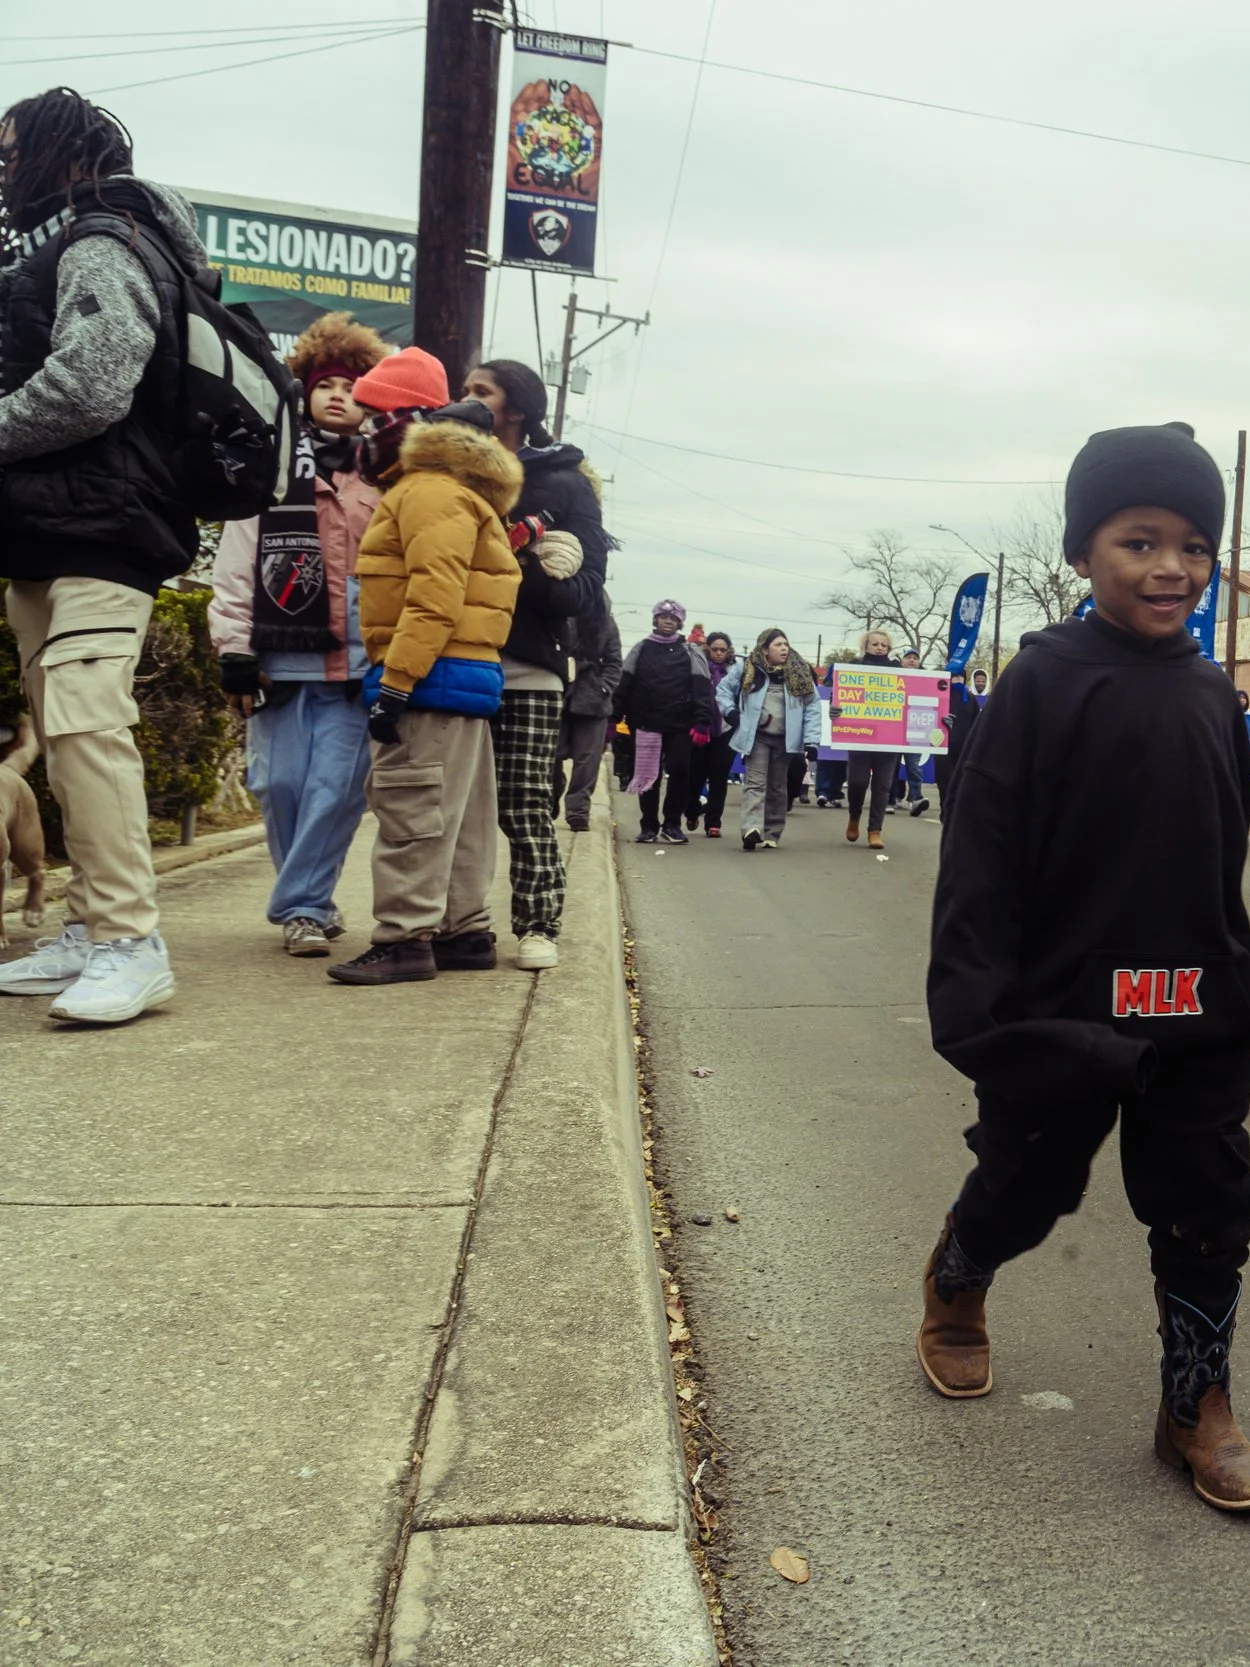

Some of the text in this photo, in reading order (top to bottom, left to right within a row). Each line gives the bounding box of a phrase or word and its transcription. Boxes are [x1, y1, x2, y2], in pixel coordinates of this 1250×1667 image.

[517, 31, 606, 58] LET FREEDOM RING
[548, 78, 572, 95] NO
[513, 162, 590, 195] EQUAL
[206, 215, 417, 283] LESIONADO?
[228, 264, 301, 292] TRATAMOS
[305, 275, 348, 297] COMO
[351, 280, 411, 305] FAMILIA!
[264, 538, 284, 548] SAN
[838, 673, 906, 689] ONE PILL A
[837, 689, 905, 704] DAY KEEPS
[840, 705, 902, 719] HIV AWAY!
[909, 712, 936, 726] PrEP
[1112, 967, 1204, 1018] MLK
